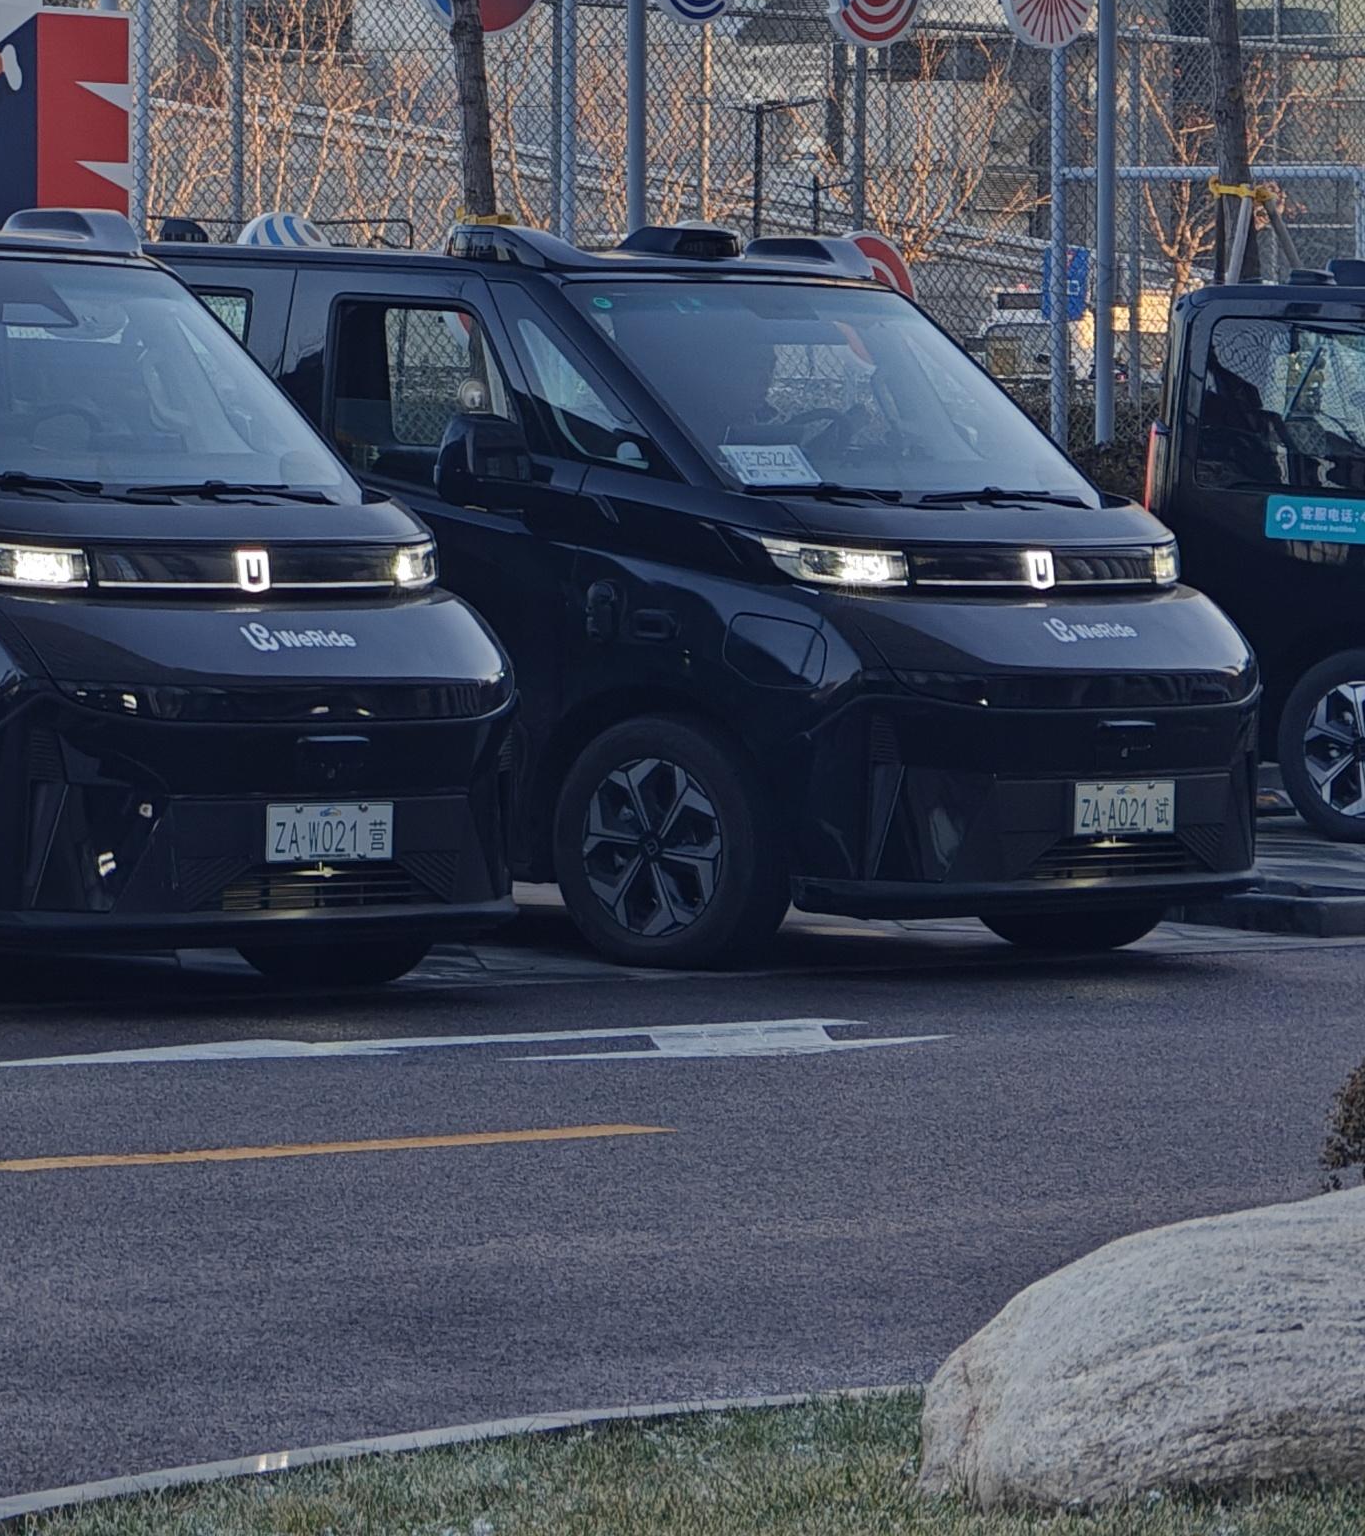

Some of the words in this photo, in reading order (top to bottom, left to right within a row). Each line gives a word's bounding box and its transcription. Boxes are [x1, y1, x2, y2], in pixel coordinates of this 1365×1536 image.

[272, 629, 358, 648] WeRide
[1070, 622, 1138, 639] WeRide
[368, 819, 387, 851] 营
